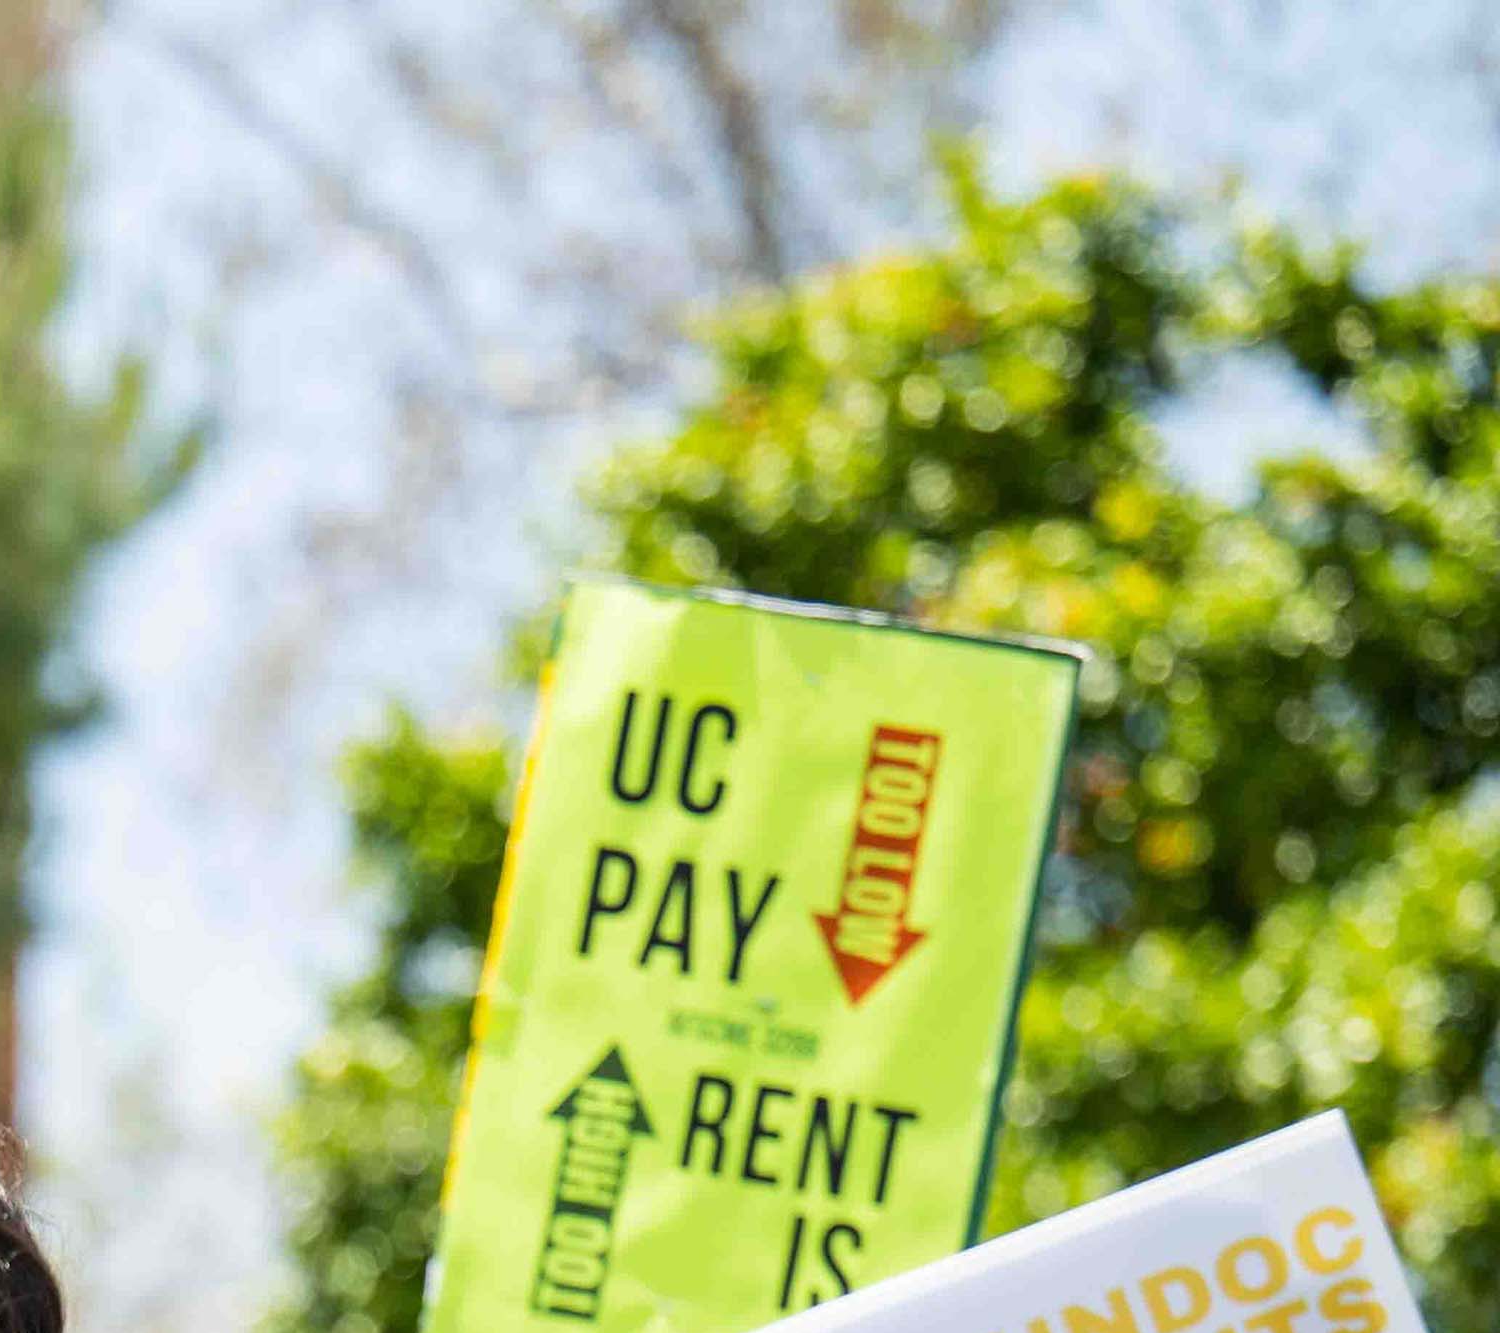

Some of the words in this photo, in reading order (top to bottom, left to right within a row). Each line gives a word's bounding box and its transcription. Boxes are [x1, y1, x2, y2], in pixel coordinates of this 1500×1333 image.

[609, 690, 738, 817] UC
[858, 735, 941, 841] TOO
[577, 847, 781, 985] PAY
[834, 846, 914, 965] LOW
[559, 1080, 638, 1212] HIGH
[679, 1071, 921, 1207] RENT
[537, 1213, 609, 1316] TOO
[776, 1215, 865, 1312] IS
